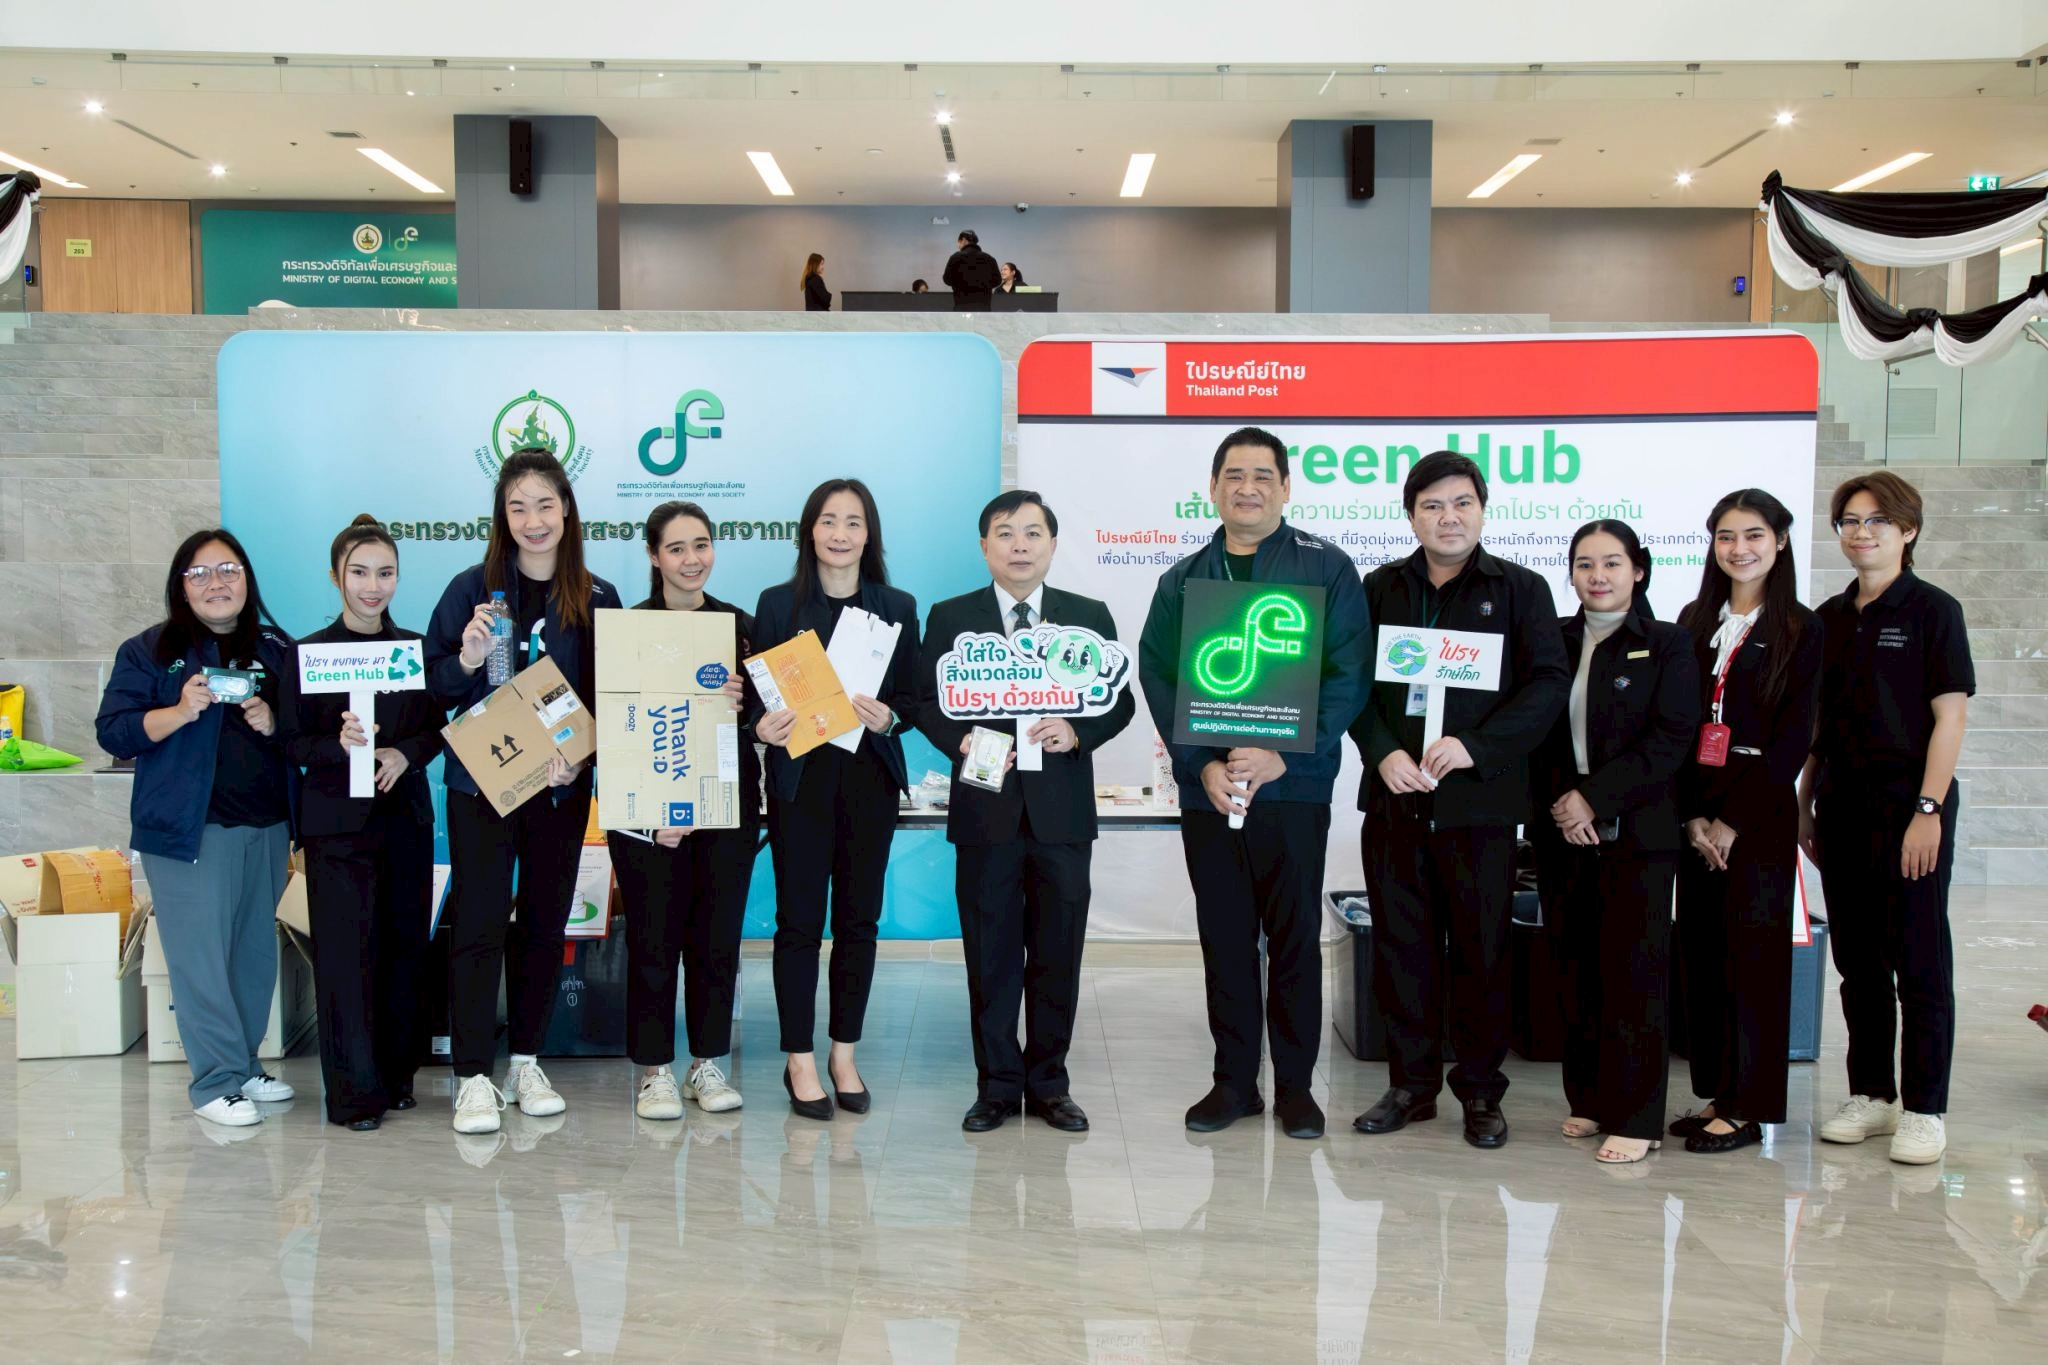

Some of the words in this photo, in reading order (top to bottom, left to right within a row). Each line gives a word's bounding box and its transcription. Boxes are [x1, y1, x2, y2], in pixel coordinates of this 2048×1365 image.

[282, 275, 324, 283] MINISTRY
[328, 275, 340, 284] OF
[344, 275, 378, 285] DIGITAL
[381, 276, 424, 285] ECONOMY
[429, 276, 448, 285] AND
[1186, 360, 1306, 380] ไปรษณีย์ไทย
[1186, 385, 1244, 396] Thailand
[1248, 385, 1278, 396] Post
[474, 448, 492, 479] Ministry
[1567, 497, 1643, 520] ด้วยกัน
[1095, 529, 1177, 544] ไปรษณีย์ไทย
[964, 641, 1007, 662] ใส่ใจ
[306, 670, 351, 682] Green
[355, 668, 385, 680] Hub
[946, 661, 1043, 682] สิ่งแวดล้อม
[945, 684, 996, 708] ไปรฯ
[1003, 683, 1075, 706] ด้วยกัน
[648, 705, 668, 752] you
[671, 699, 692, 781] Thank
